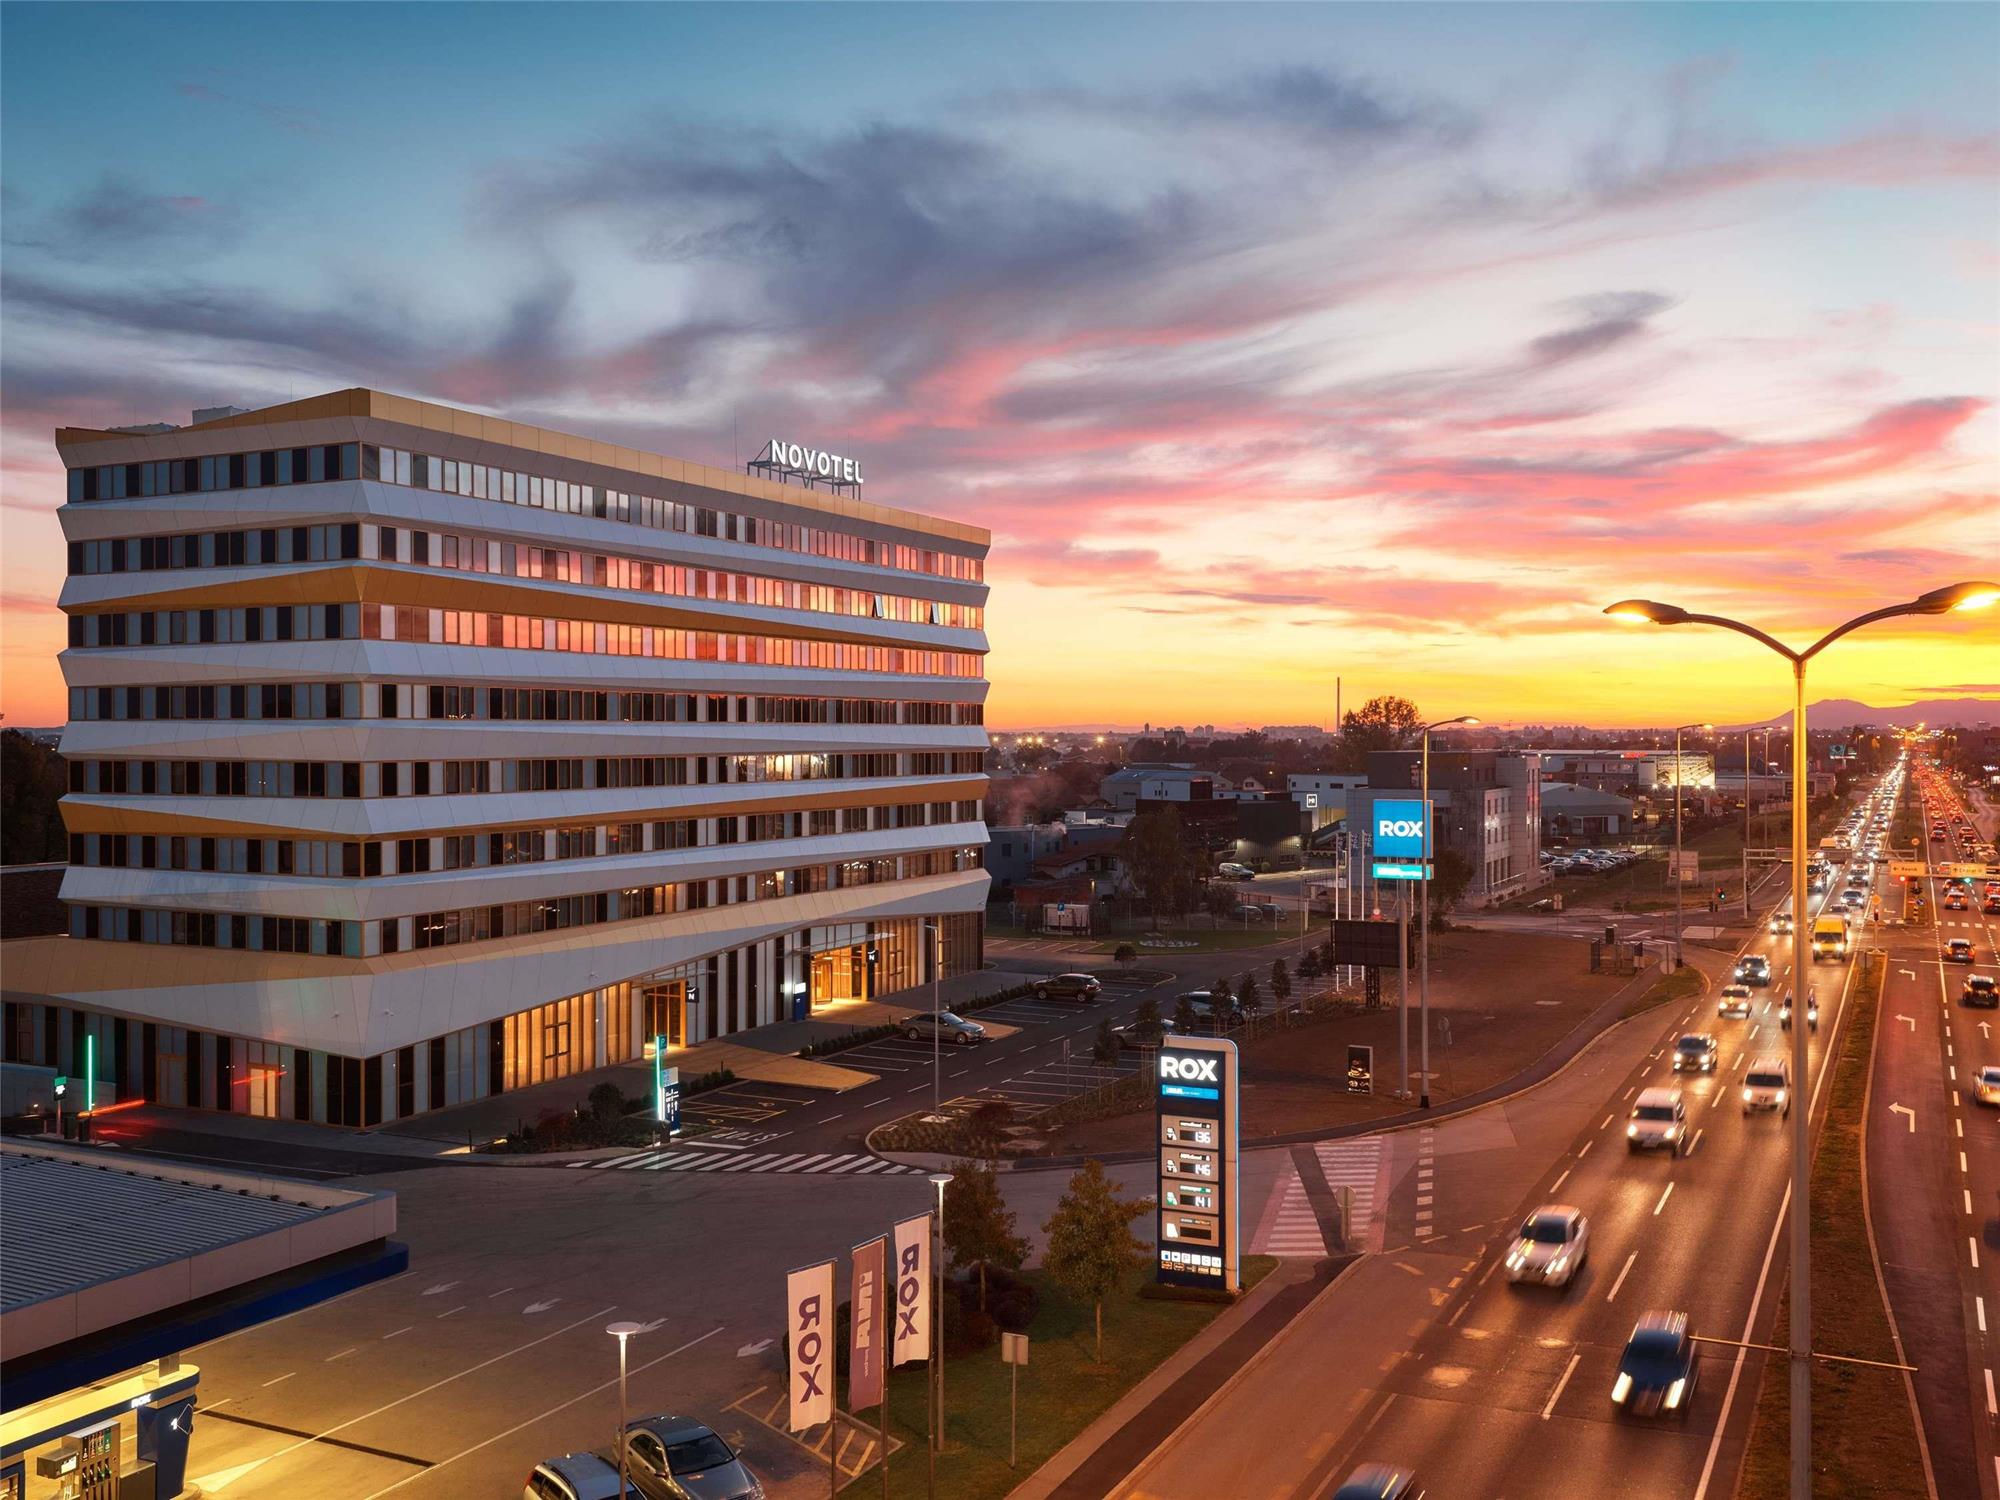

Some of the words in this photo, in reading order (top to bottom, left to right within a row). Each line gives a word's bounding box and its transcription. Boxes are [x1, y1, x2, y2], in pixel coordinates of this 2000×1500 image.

[771, 439, 864, 483] NOVOTEL
[1379, 820, 1423, 838] ROX
[1160, 1055, 1218, 1082] ROX
